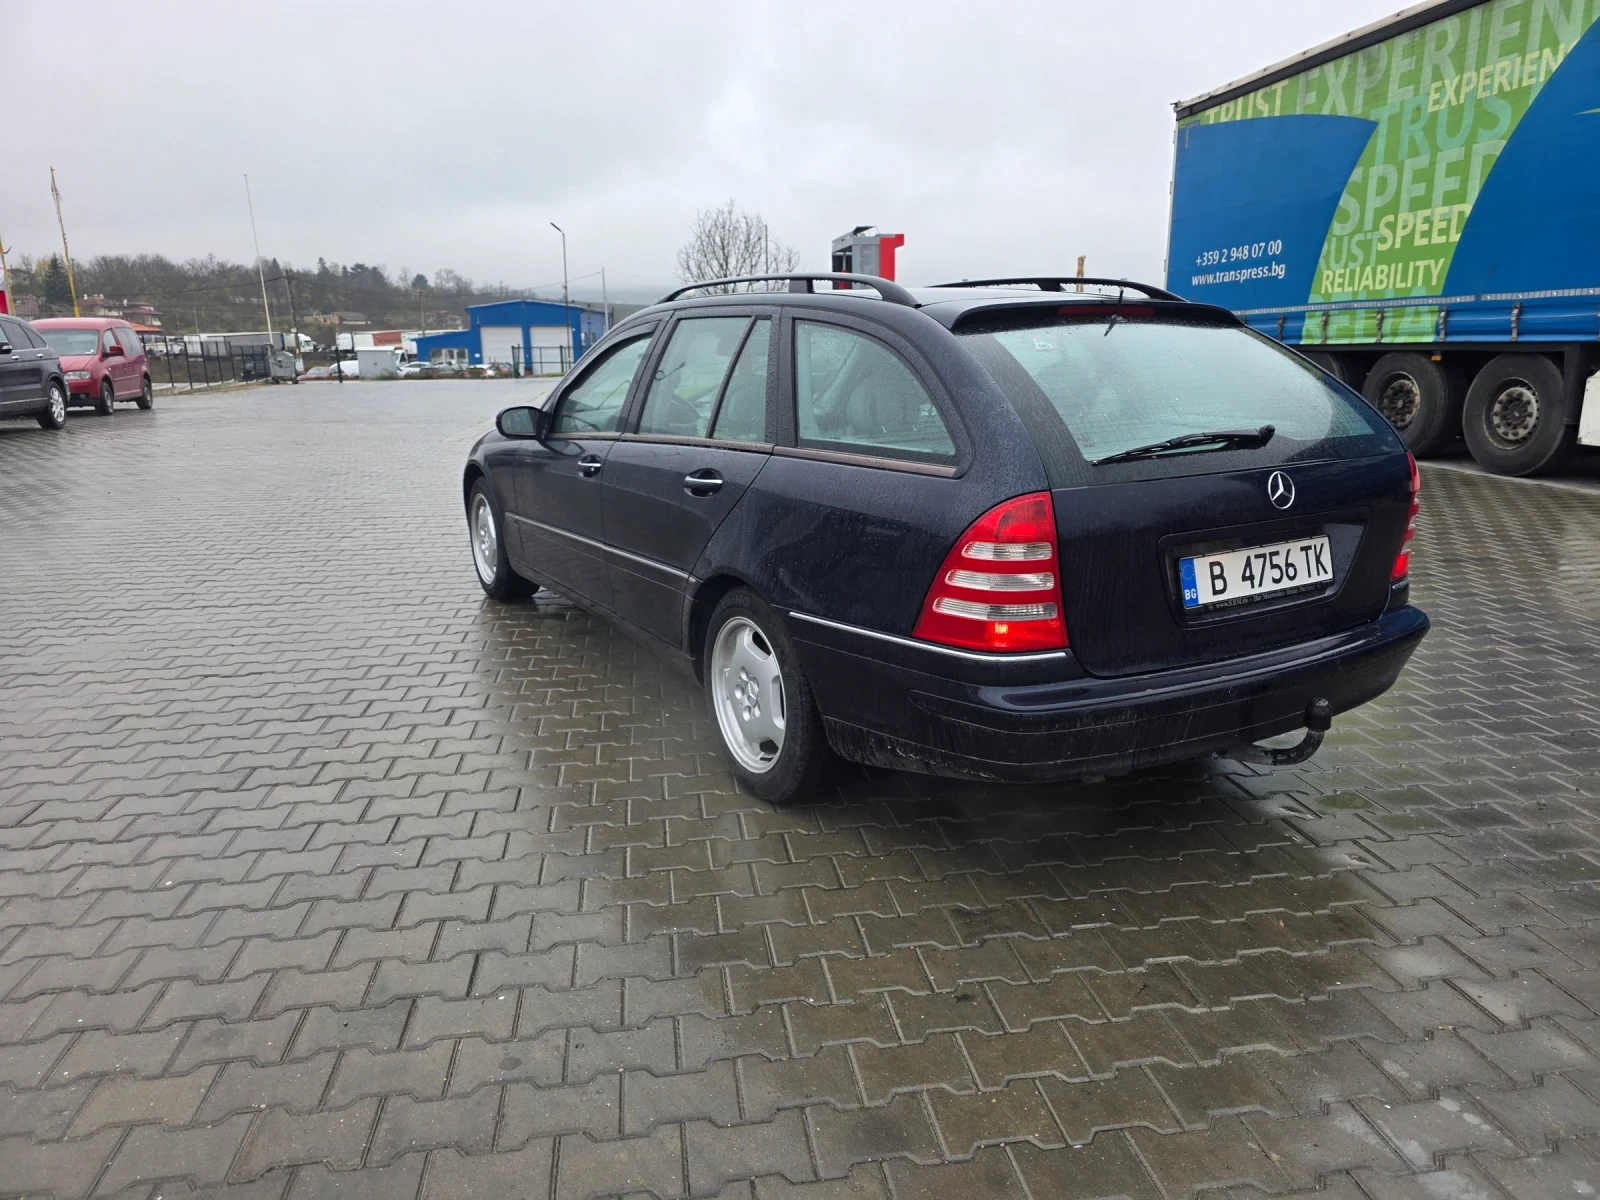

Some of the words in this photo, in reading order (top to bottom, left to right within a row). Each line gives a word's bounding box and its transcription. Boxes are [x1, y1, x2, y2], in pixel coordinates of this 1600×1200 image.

[1296, 0, 1600, 116] EXPERIEN
[1428, 42, 1569, 112] EXPERIEN
[1205, 79, 1289, 125] TRUST
[1371, 76, 1530, 165] TRUS
[1378, 203, 1473, 251] SPEED
[1191, 261, 1286, 286] www.transpress.bg
[1195, 250, 1220, 267] +359
[1221, 248, 1228, 263] 2
[1230, 245, 1250, 261] 948
[1251, 242, 1266, 258] 07
[1267, 239, 1282, 256] 00
[1321, 258, 1445, 294] RELIABILITY
[1209, 560, 1228, 596] B
[1241, 548, 1298, 589] 4756
[1300, 542, 1329, 579] TK
[1184, 588, 1197, 600] BG
